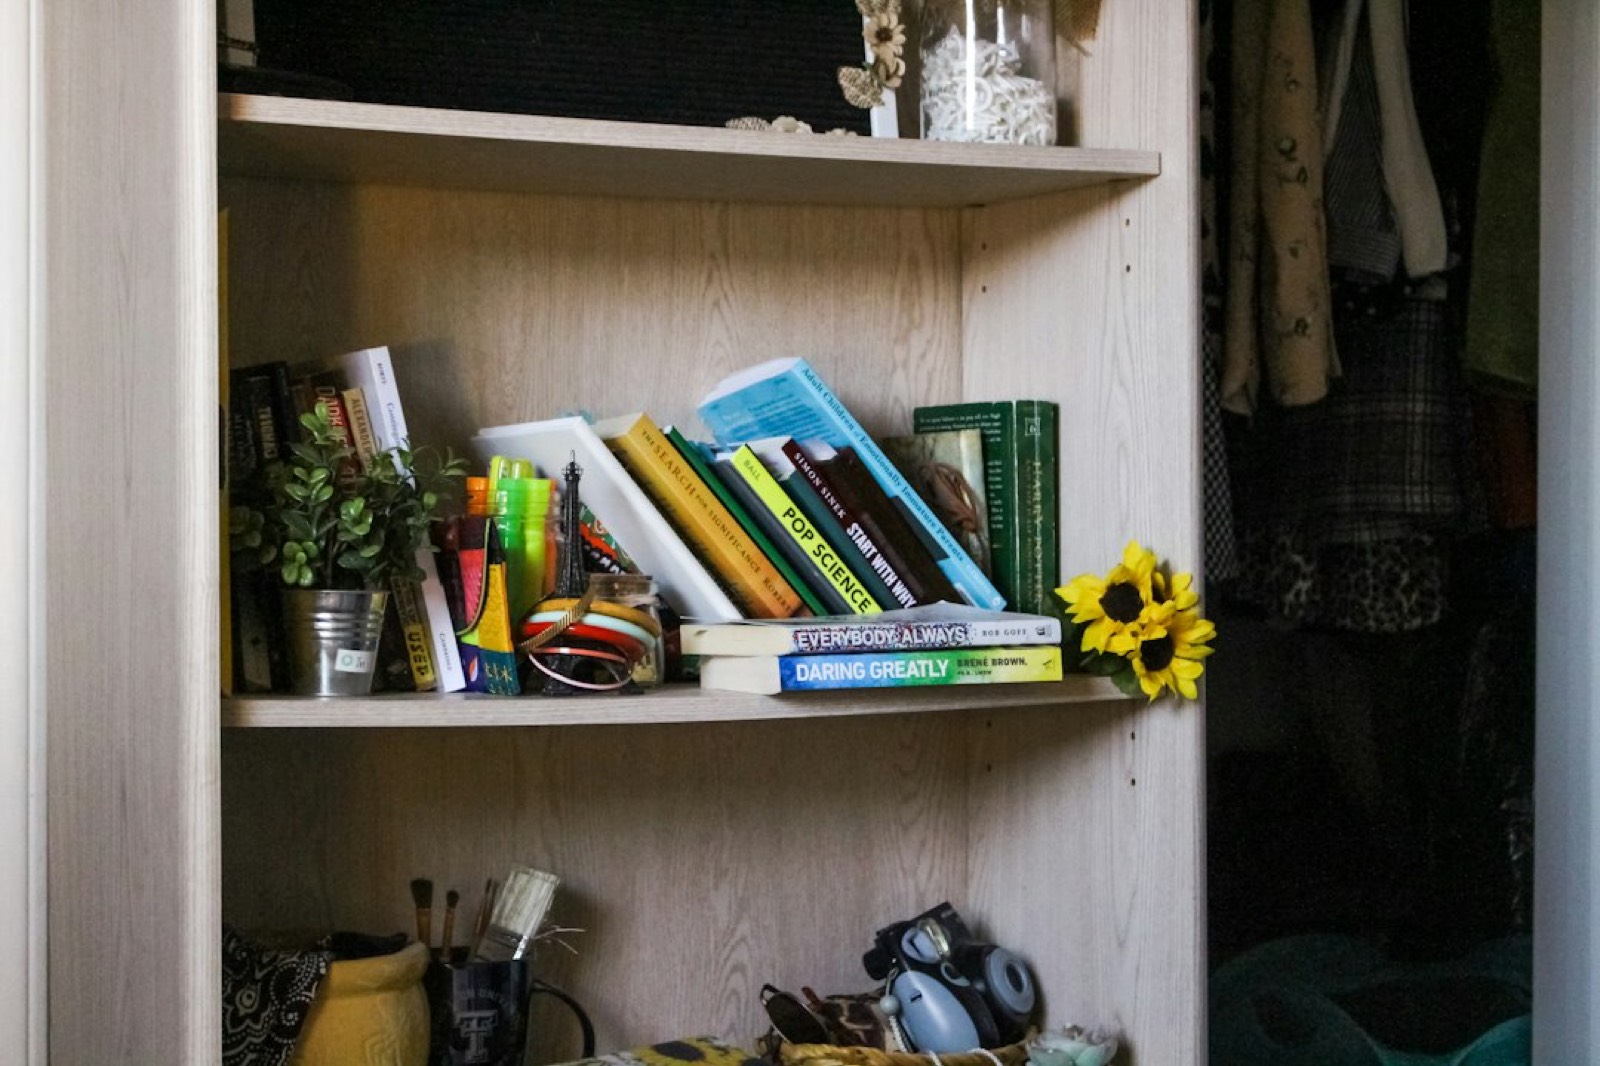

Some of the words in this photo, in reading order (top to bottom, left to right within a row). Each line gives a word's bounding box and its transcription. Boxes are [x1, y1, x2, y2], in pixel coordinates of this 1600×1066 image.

[743, 459, 761, 482] BALL
[794, 452, 822, 487] SIMON
[820, 486, 847, 519] SINEK
[802, 367, 824, 392] Adult
[822, 391, 854, 431] Children
[859, 436, 901, 487] Emotionally
[902, 486, 937, 530] Immature
[937, 528, 964, 562] Parents
[1031, 460, 1044, 527] HARRY
[642, 430, 656, 447] THE
[655, 445, 697, 496] SEARCH
[708, 509, 762, 574] SIGNIFICANCE
[782, 507, 814, 542] POP
[812, 544, 872, 613] SCIENCE
[846, 522, 877, 559] START
[871, 552, 898, 587] WITH
[892, 580, 917, 609] WHY
[1031, 535, 1045, 605] POTTER
[901, 626, 966, 644] ALWAYS
[981, 629, 1000, 638] BOB
[1003, 628, 1027, 636] GOFF
[796, 660, 865, 682] DARING
[870, 659, 949, 680] GREATLY
